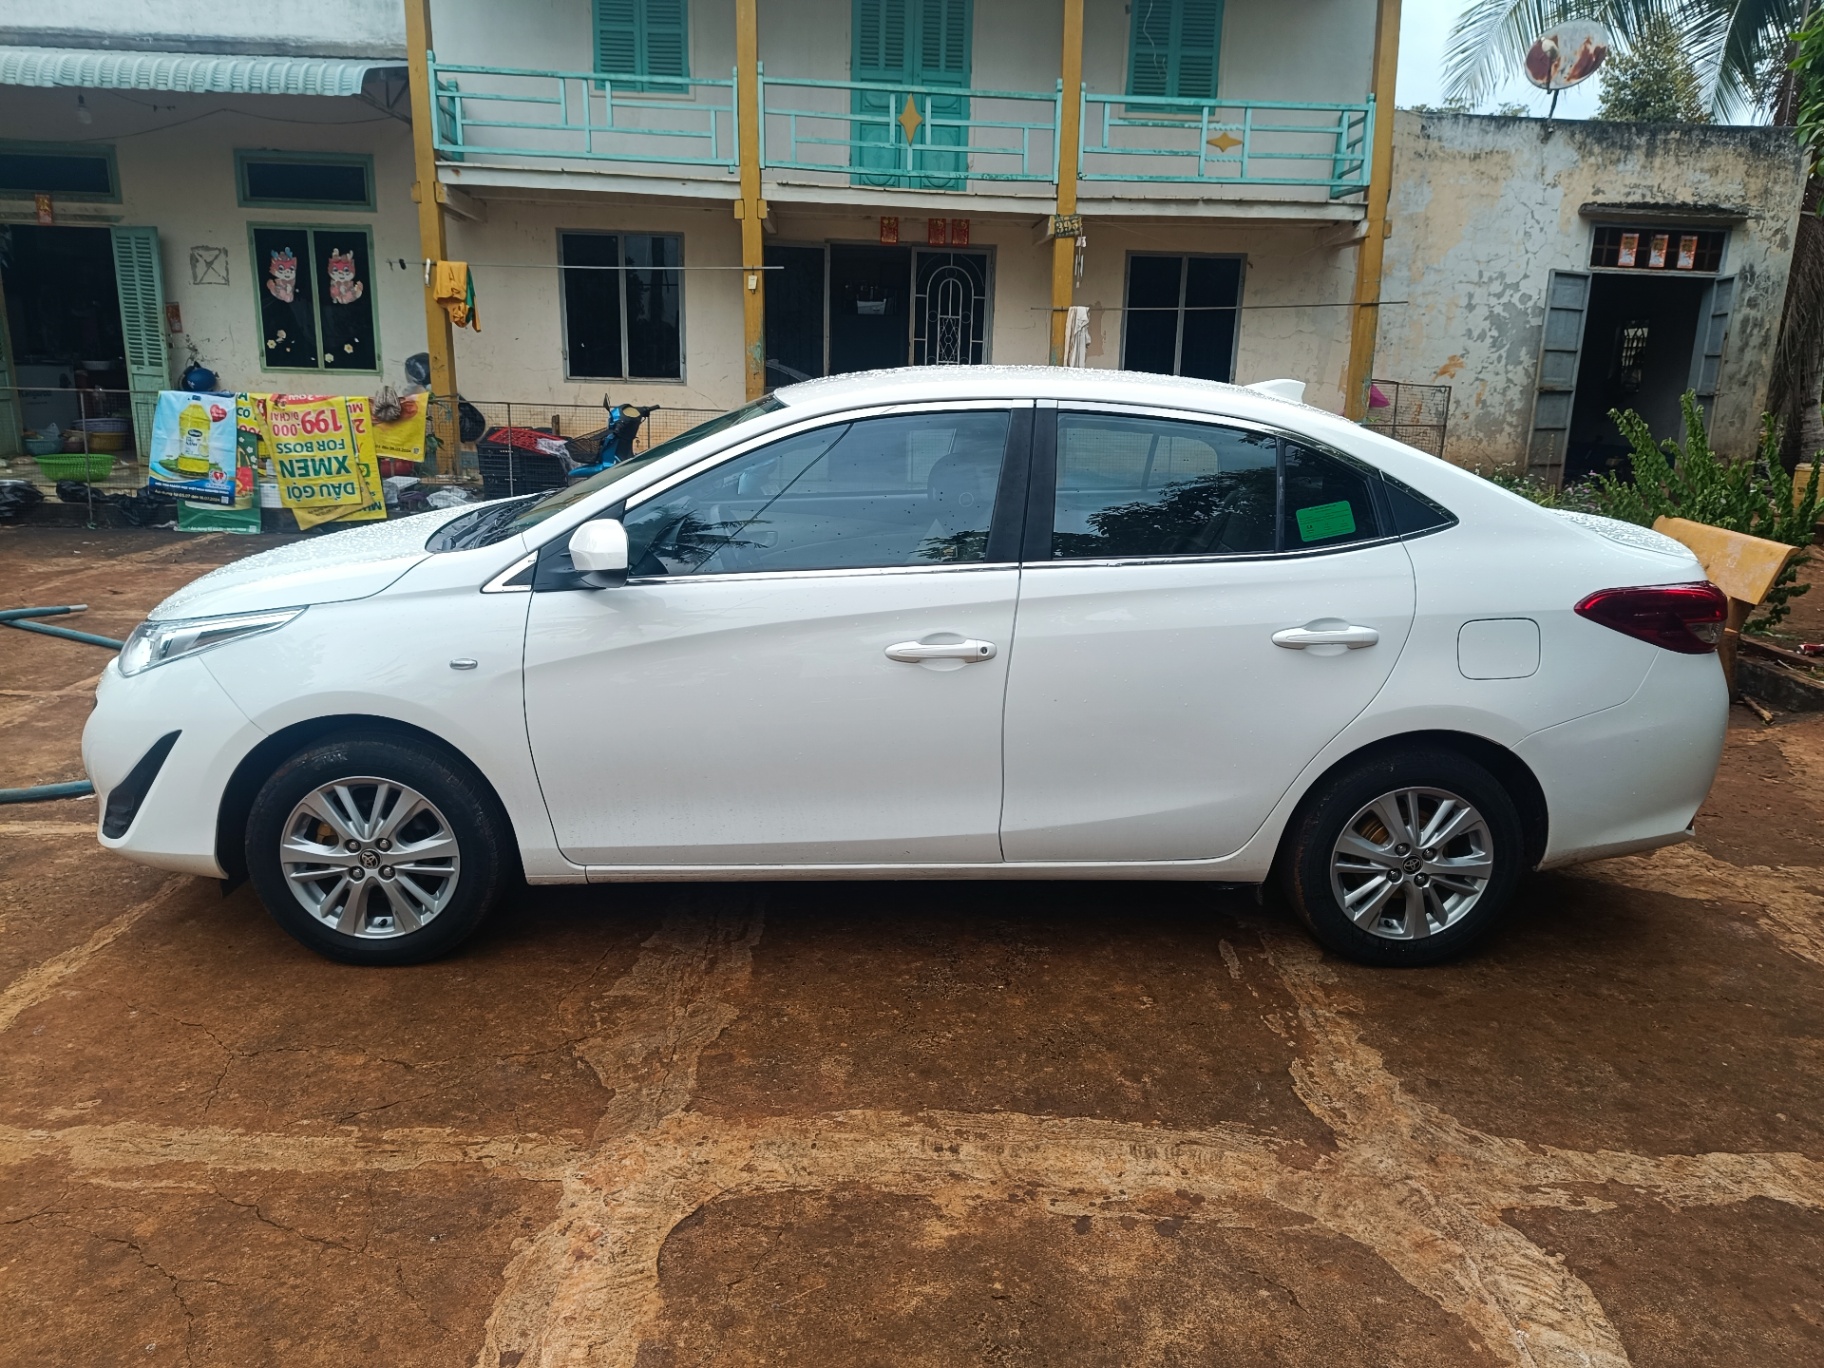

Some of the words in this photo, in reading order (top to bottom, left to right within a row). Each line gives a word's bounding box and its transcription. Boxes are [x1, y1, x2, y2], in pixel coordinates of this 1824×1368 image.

[276, 441, 314, 454] BOSS
[317, 439, 346, 451] FOR
[278, 456, 352, 478] XMEN
[286, 482, 316, 502] GỘI
[319, 482, 356, 500] DẦU
